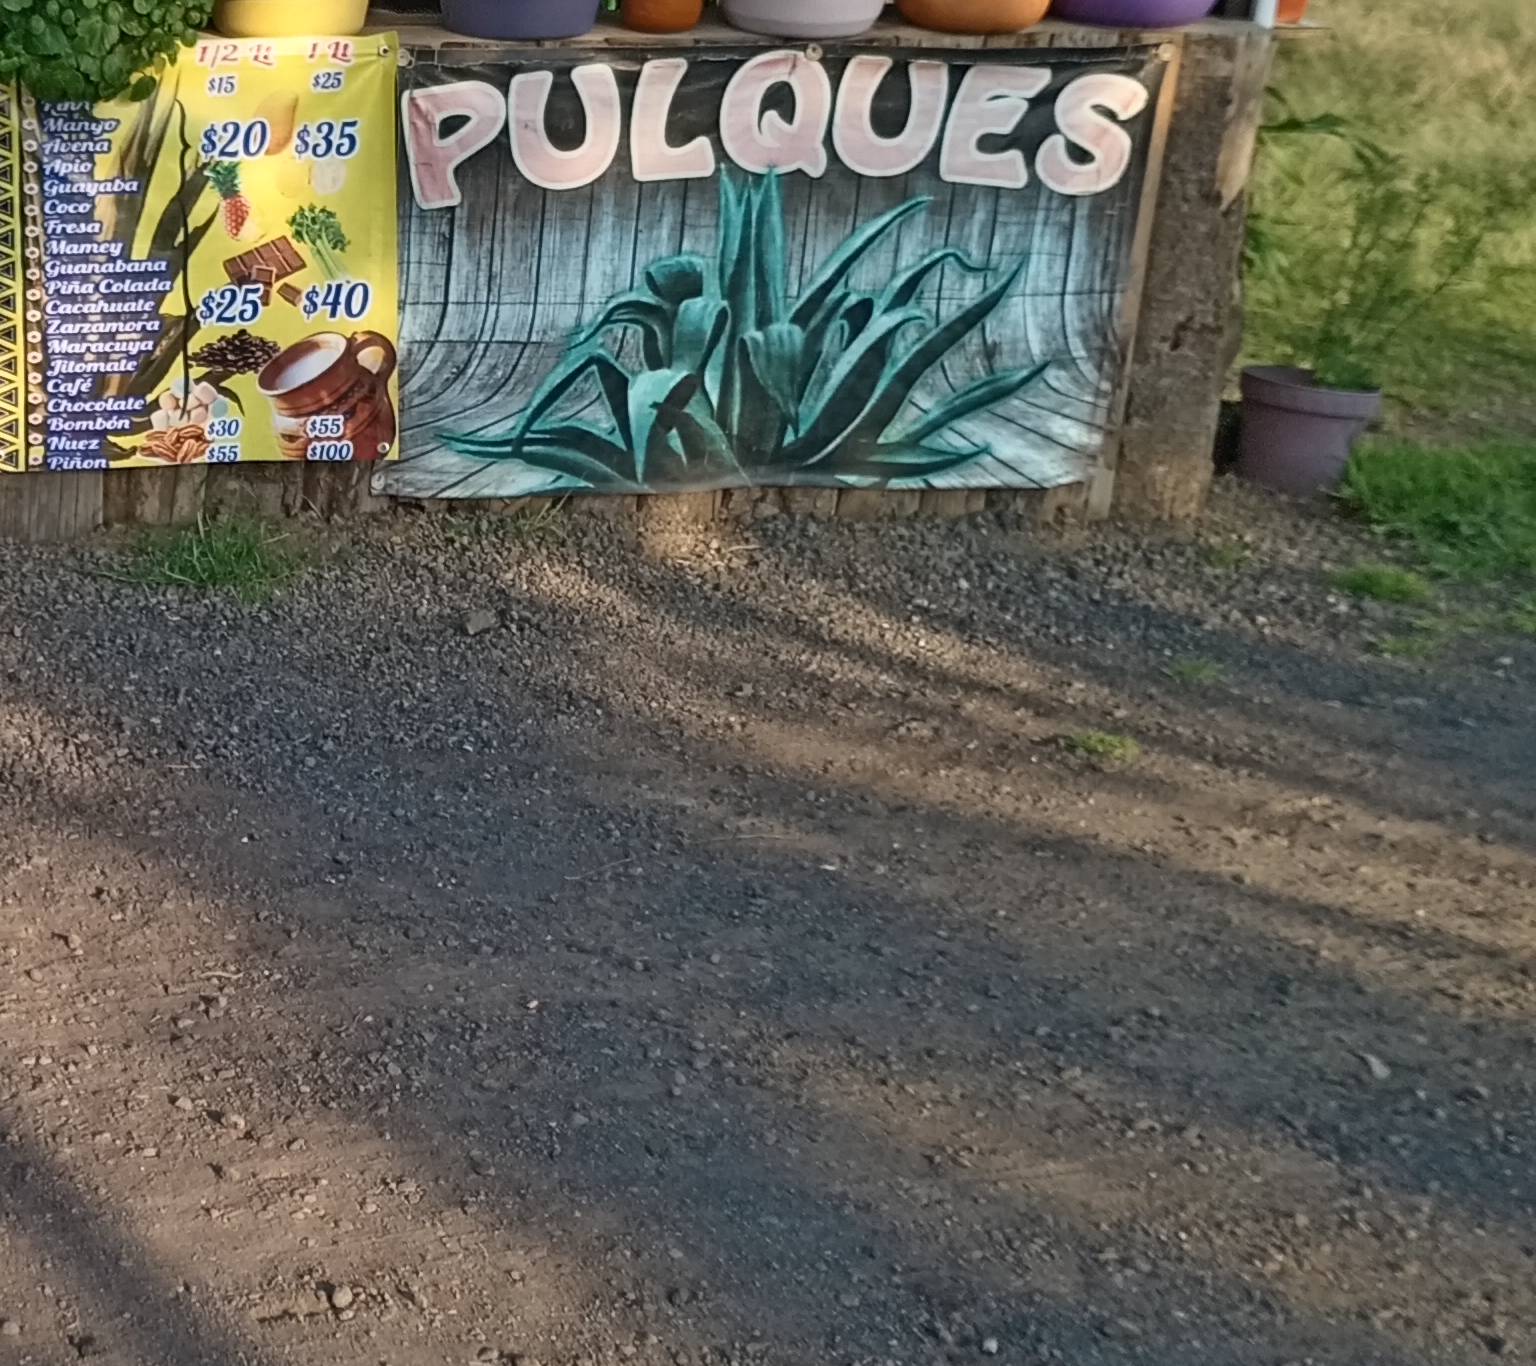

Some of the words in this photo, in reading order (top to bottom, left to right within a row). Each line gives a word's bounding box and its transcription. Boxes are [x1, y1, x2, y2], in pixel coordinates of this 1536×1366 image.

[198, 43, 239, 68] 1/2
[308, 42, 319, 59] 1
[208, 75, 236, 94] $15
[312, 71, 343, 90] $25
[43, 117, 118, 135] Mango
[400, 49, 1149, 210] PULQUES
[42, 137, 110, 154] Avena
[201, 120, 268, 159] $20
[294, 119, 359, 159] $35
[42, 158, 93, 176] Apio
[43, 178, 139, 197] Guayaba
[43, 199, 93, 214] Coco
[44, 219, 102, 235] Fresa
[45, 239, 124, 257] Mamey
[44, 259, 168, 278] Guanabana
[45, 279, 95, 295] Piña
[98, 278, 172, 294] Colada
[45, 298, 156, 315] Cacahuate
[199, 286, 262, 325] $25
[302, 282, 370, 320] $40
[46, 319, 161, 334] Zarzamora
[47, 339, 154, 355] Maracuya
[46, 359, 138, 377] Jitomate
[46, 377, 94, 396] Café
[47, 397, 146, 413] Chocolate
[46, 414, 131, 432] Bombón
[207, 419, 240, 437] $30
[308, 417, 342, 435] $55
[46, 436, 101, 451] Nuez
[308, 443, 352, 460] $100
[207, 445, 239, 462] $55
